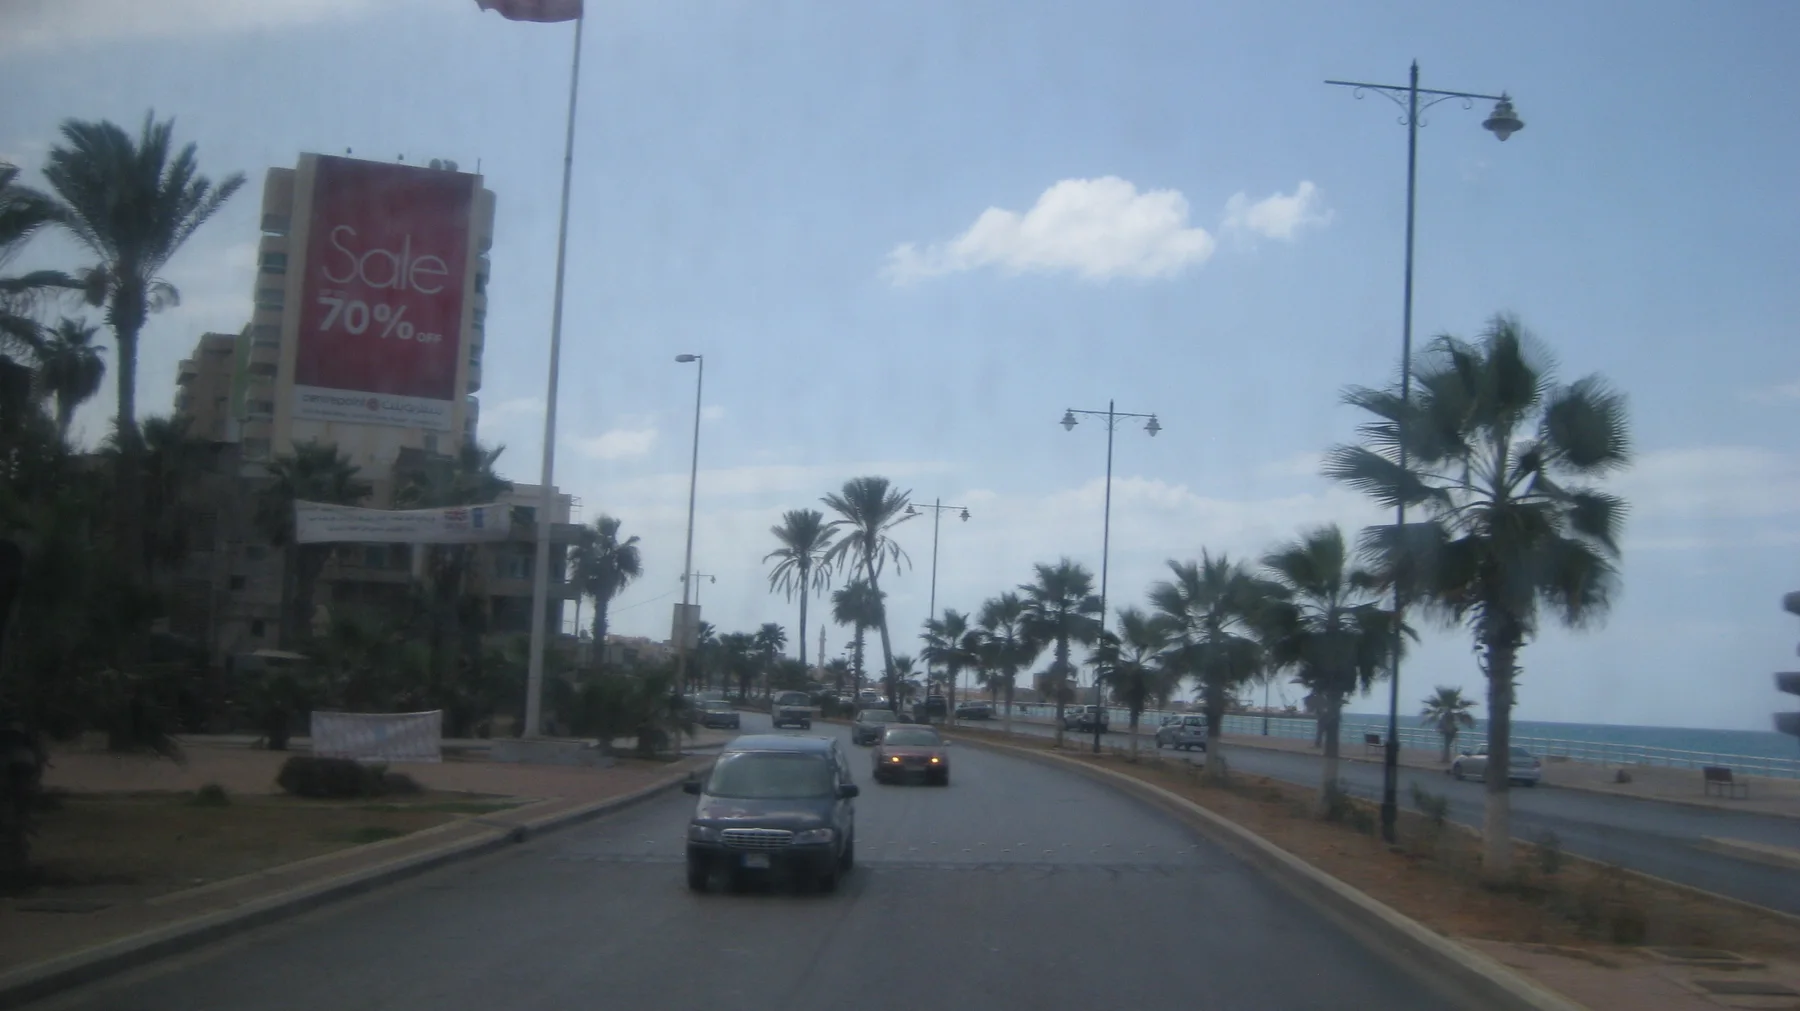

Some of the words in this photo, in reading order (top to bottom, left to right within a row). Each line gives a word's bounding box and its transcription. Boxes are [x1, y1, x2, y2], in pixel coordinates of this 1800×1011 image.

[322, 224, 448, 294] Sale
[317, 296, 414, 340] 70%
[416, 332, 443, 343] OFF
[302, 394, 366, 407] cenepoint
